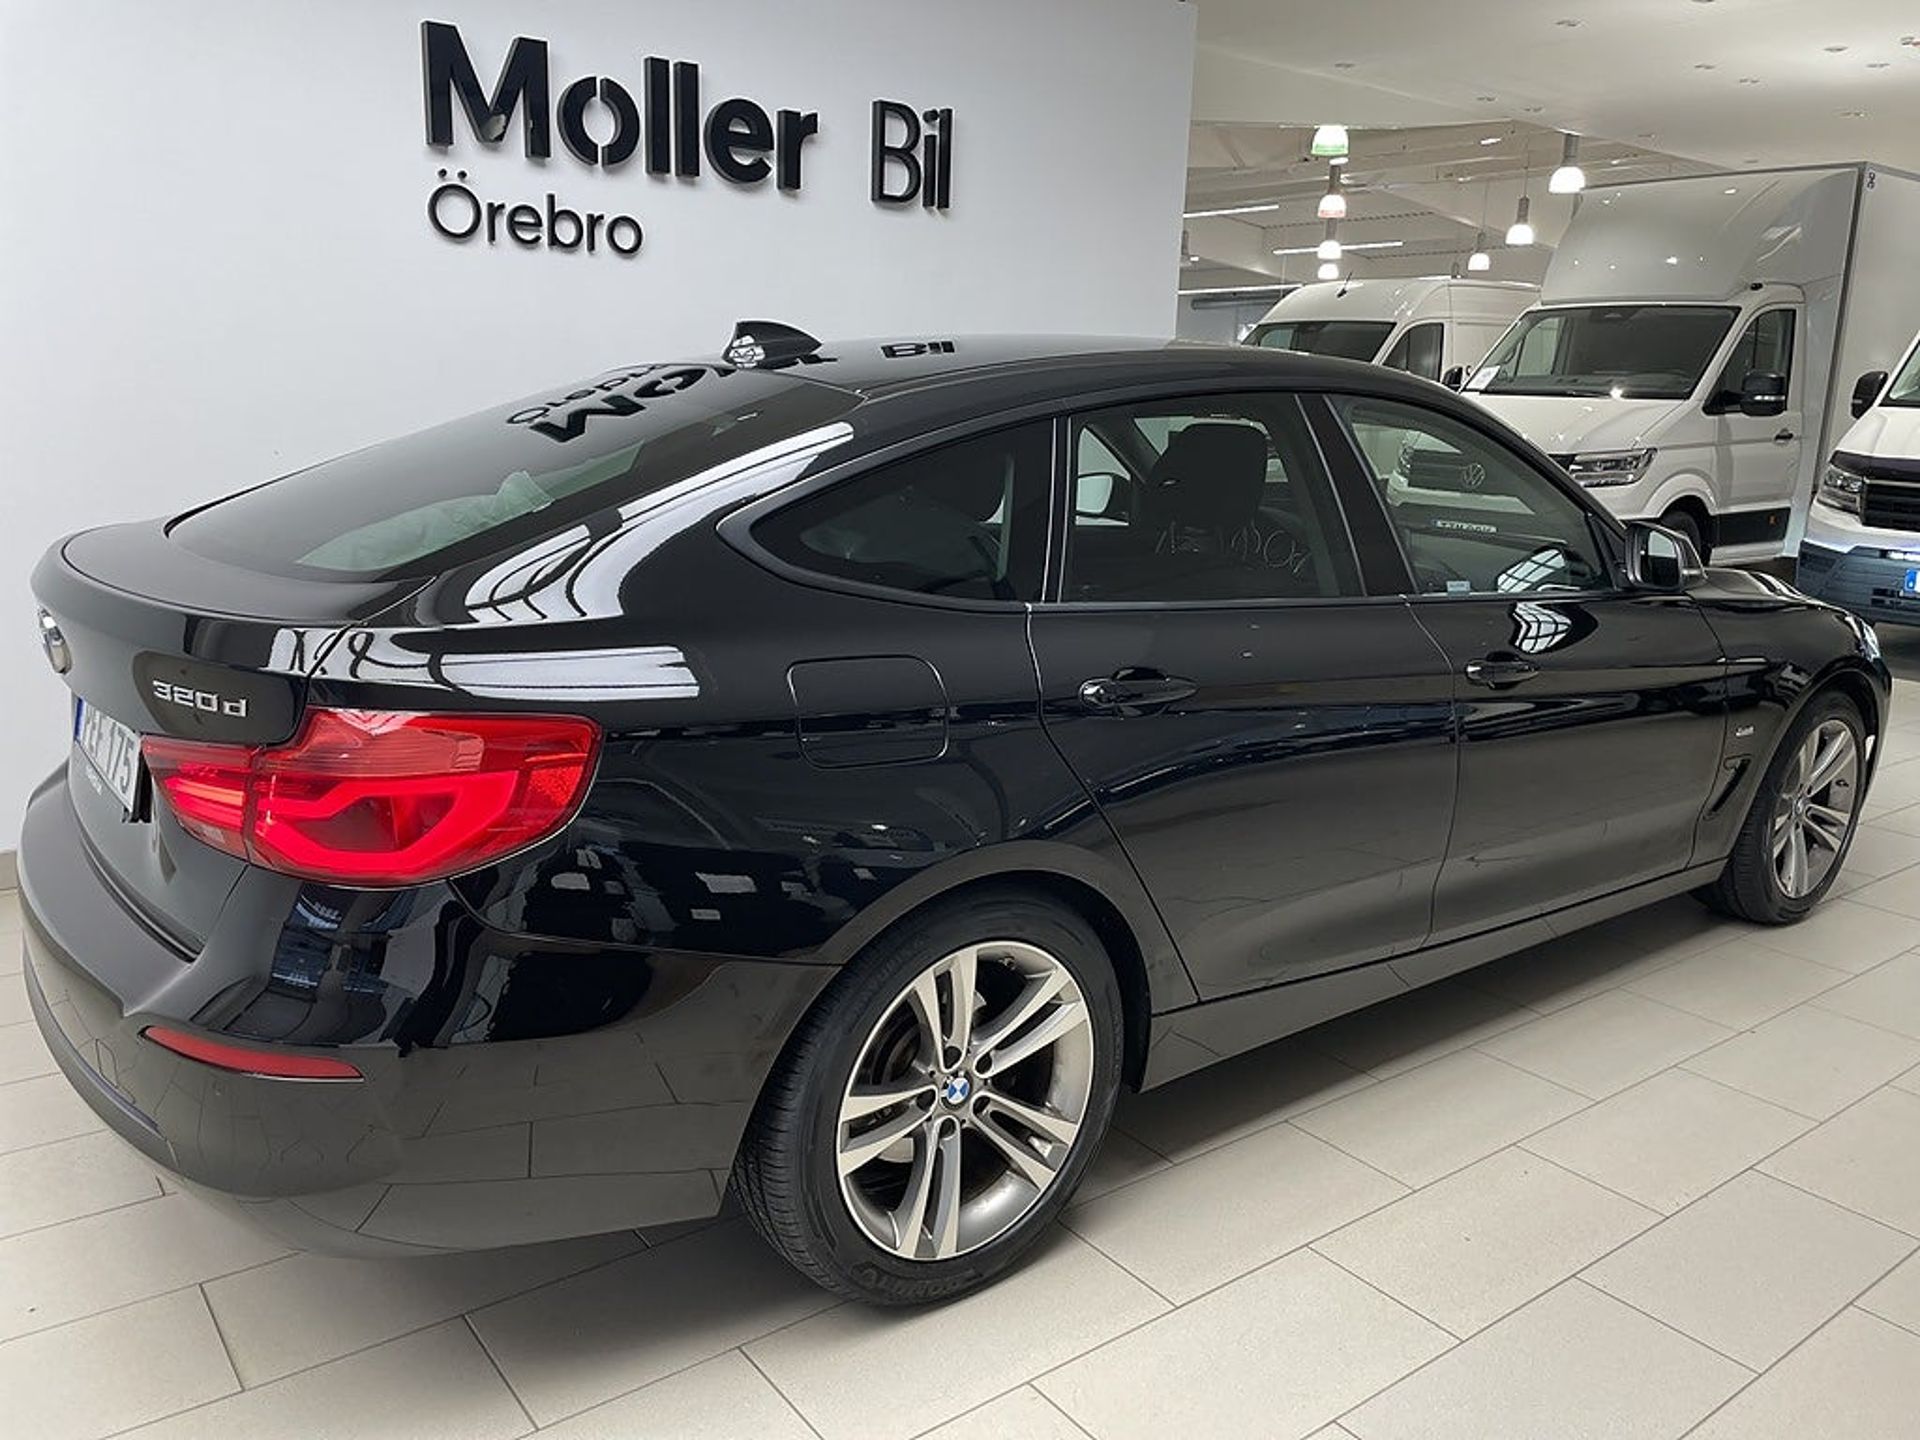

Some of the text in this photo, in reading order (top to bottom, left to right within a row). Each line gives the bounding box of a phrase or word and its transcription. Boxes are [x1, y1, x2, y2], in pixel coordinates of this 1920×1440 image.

[420, 20, 953, 209] Moller Bil
[427, 168, 643, 256] Örebro
[106, 720, 135, 794] 175
